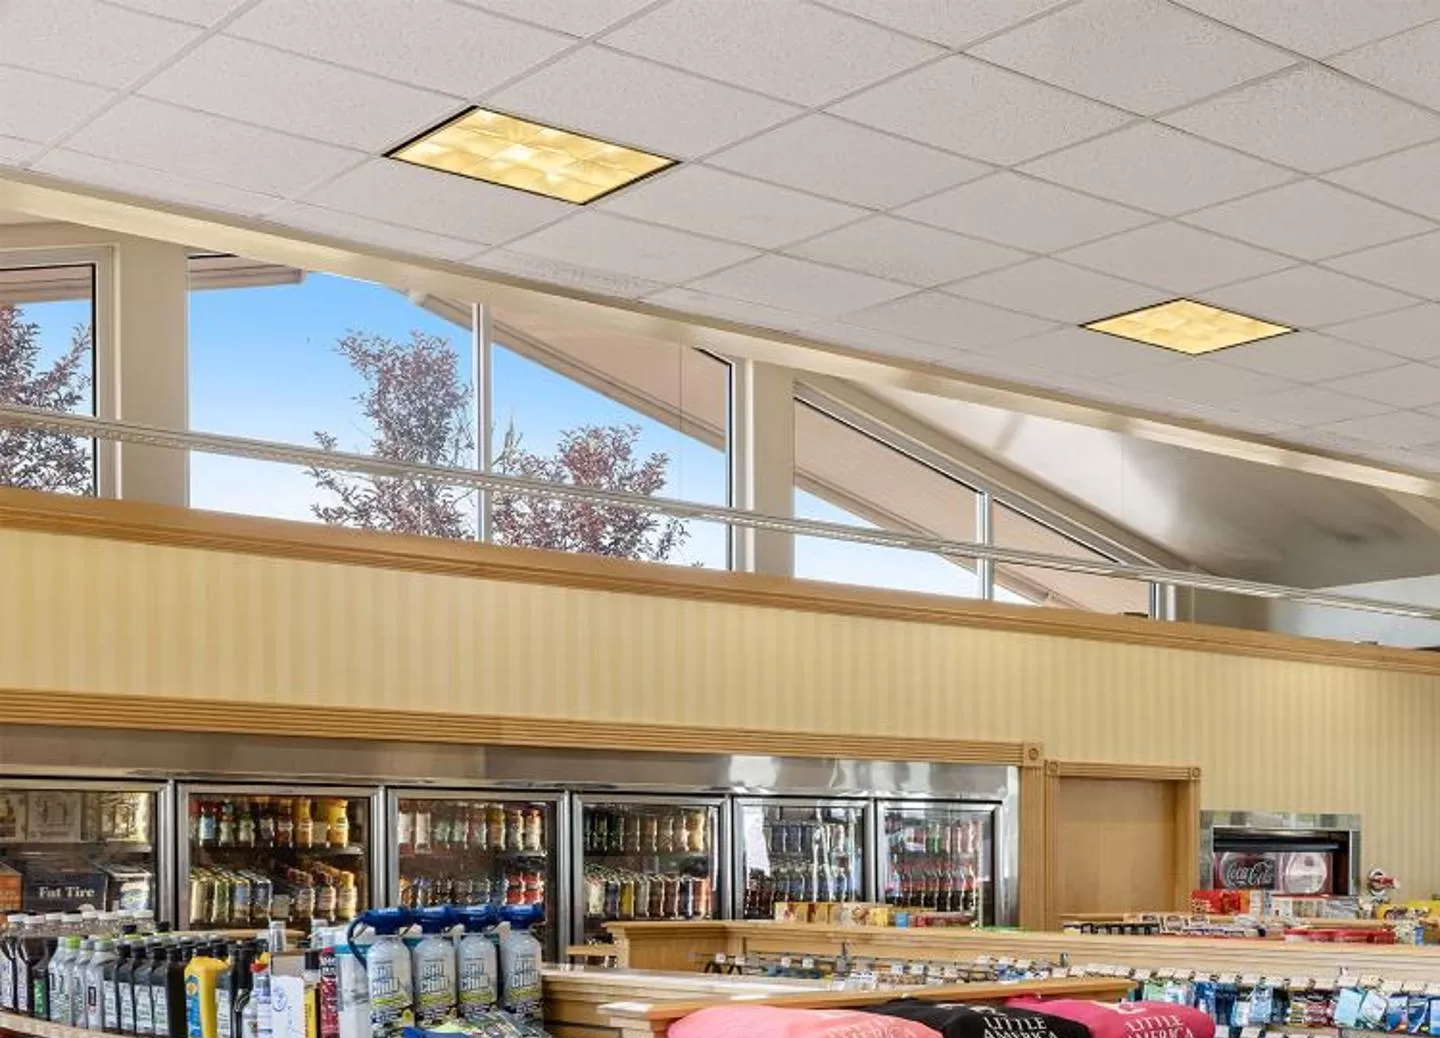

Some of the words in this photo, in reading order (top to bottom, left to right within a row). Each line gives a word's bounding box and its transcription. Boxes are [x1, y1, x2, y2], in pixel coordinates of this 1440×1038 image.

[38, 886, 60, 898] Fat
[65, 886, 95, 898] Tire
[983, 1016, 1047, 1031] LITTLE
[1124, 1014, 1184, 1032] LITTLE
